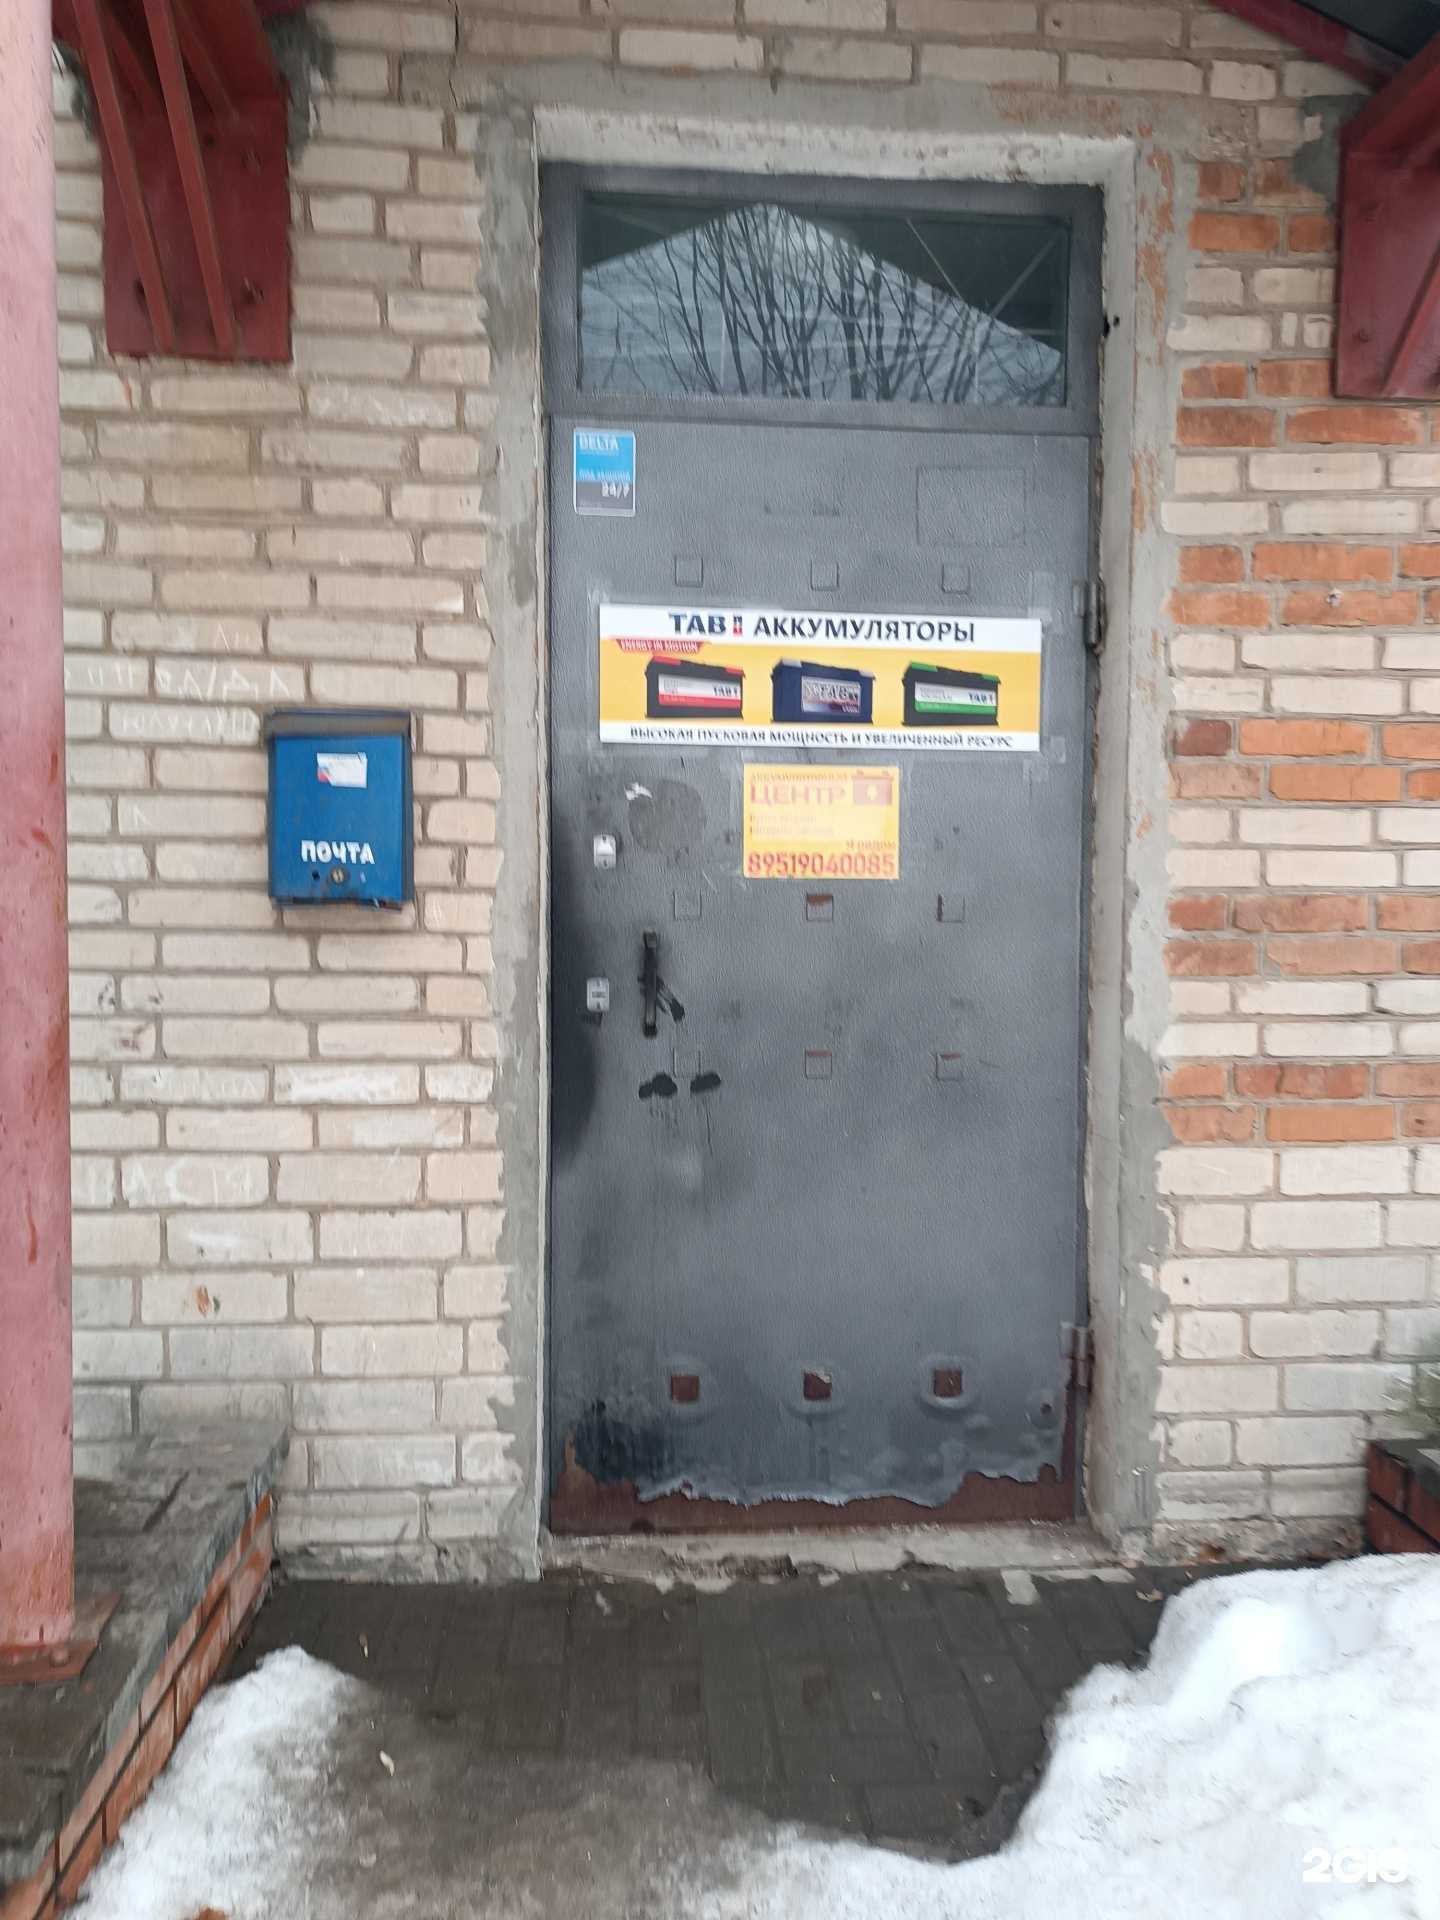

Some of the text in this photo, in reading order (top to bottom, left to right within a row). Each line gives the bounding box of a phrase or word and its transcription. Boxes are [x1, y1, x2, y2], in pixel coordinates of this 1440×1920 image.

[753, 616, 975, 643] АККУМУЛЯТОРЫ
[630, 726, 1013, 748] ВЫСОКАЯ ПУСКОВАЯ МОЩНОСТЬ И УВЕЛИЧЕННЫЙ РЕСУРС
[750, 782, 846, 805] ЦЕНТР
[301, 839, 375, 865] ПОЧТА
[747, 851, 896, 875] 89519040085
